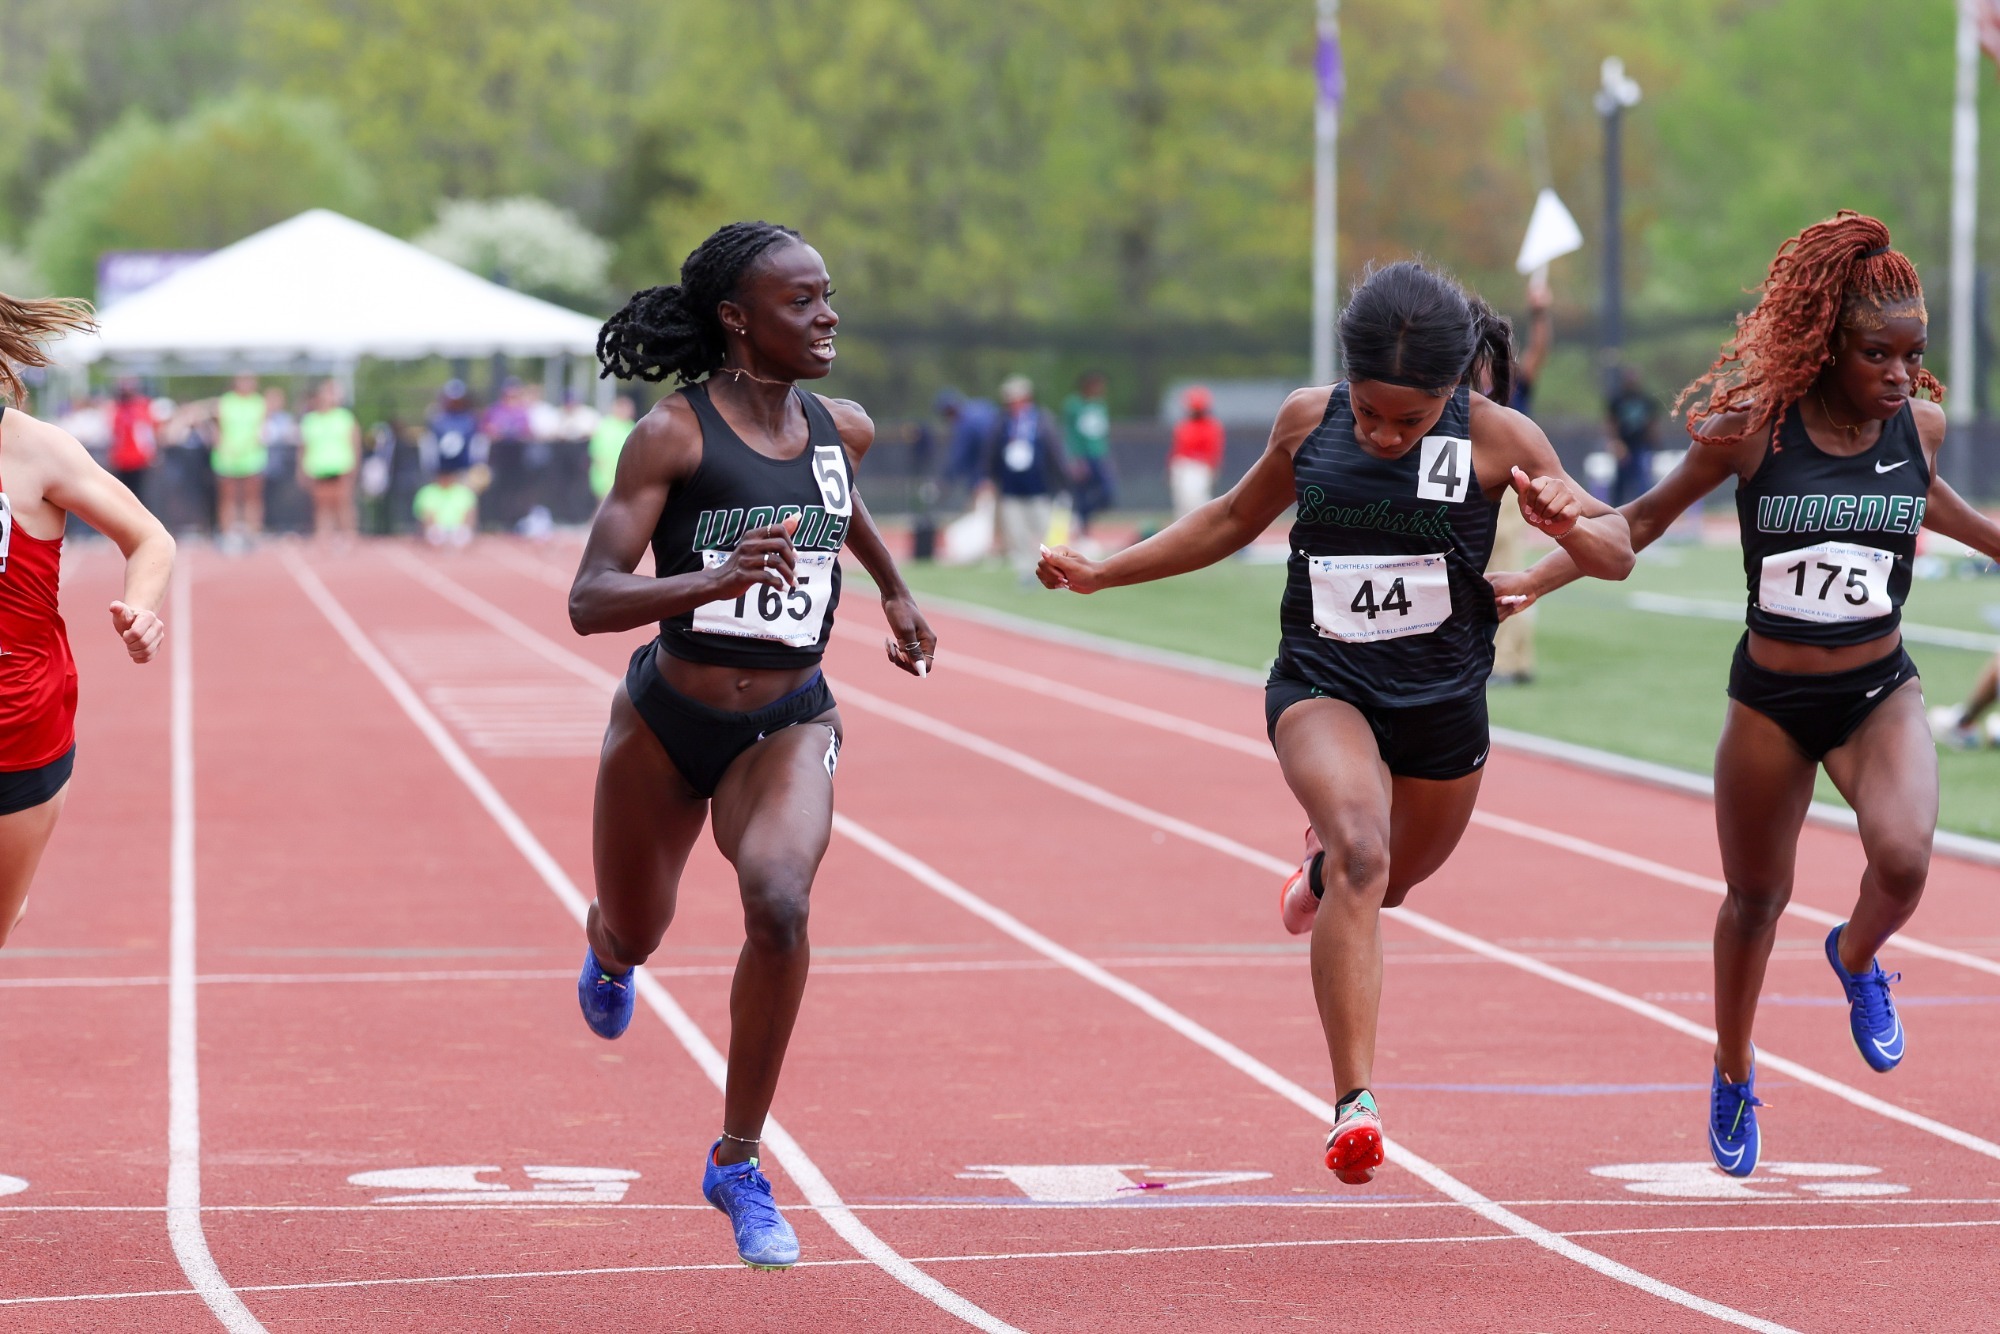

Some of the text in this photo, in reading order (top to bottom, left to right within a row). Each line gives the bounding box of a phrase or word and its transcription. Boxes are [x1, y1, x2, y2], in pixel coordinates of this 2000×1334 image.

[814, 450, 847, 510] 5
[1427, 440, 1462, 498] 4
[1297, 485, 1453, 539] Southside
[1757, 494, 1927, 535] WAGNER
[1374, 561, 1420, 570] CONFERENCE
[1787, 560, 1870, 606] 175
[734, 576, 813, 622] 165
[1350, 577, 1413, 620] 44
[1769, 602, 1797, 612] OUTDOOR
[1797, 607, 1815, 616] TRACK
[704, 627, 736, 636] OUTDOOR
[738, 631, 758, 639] TRACK
